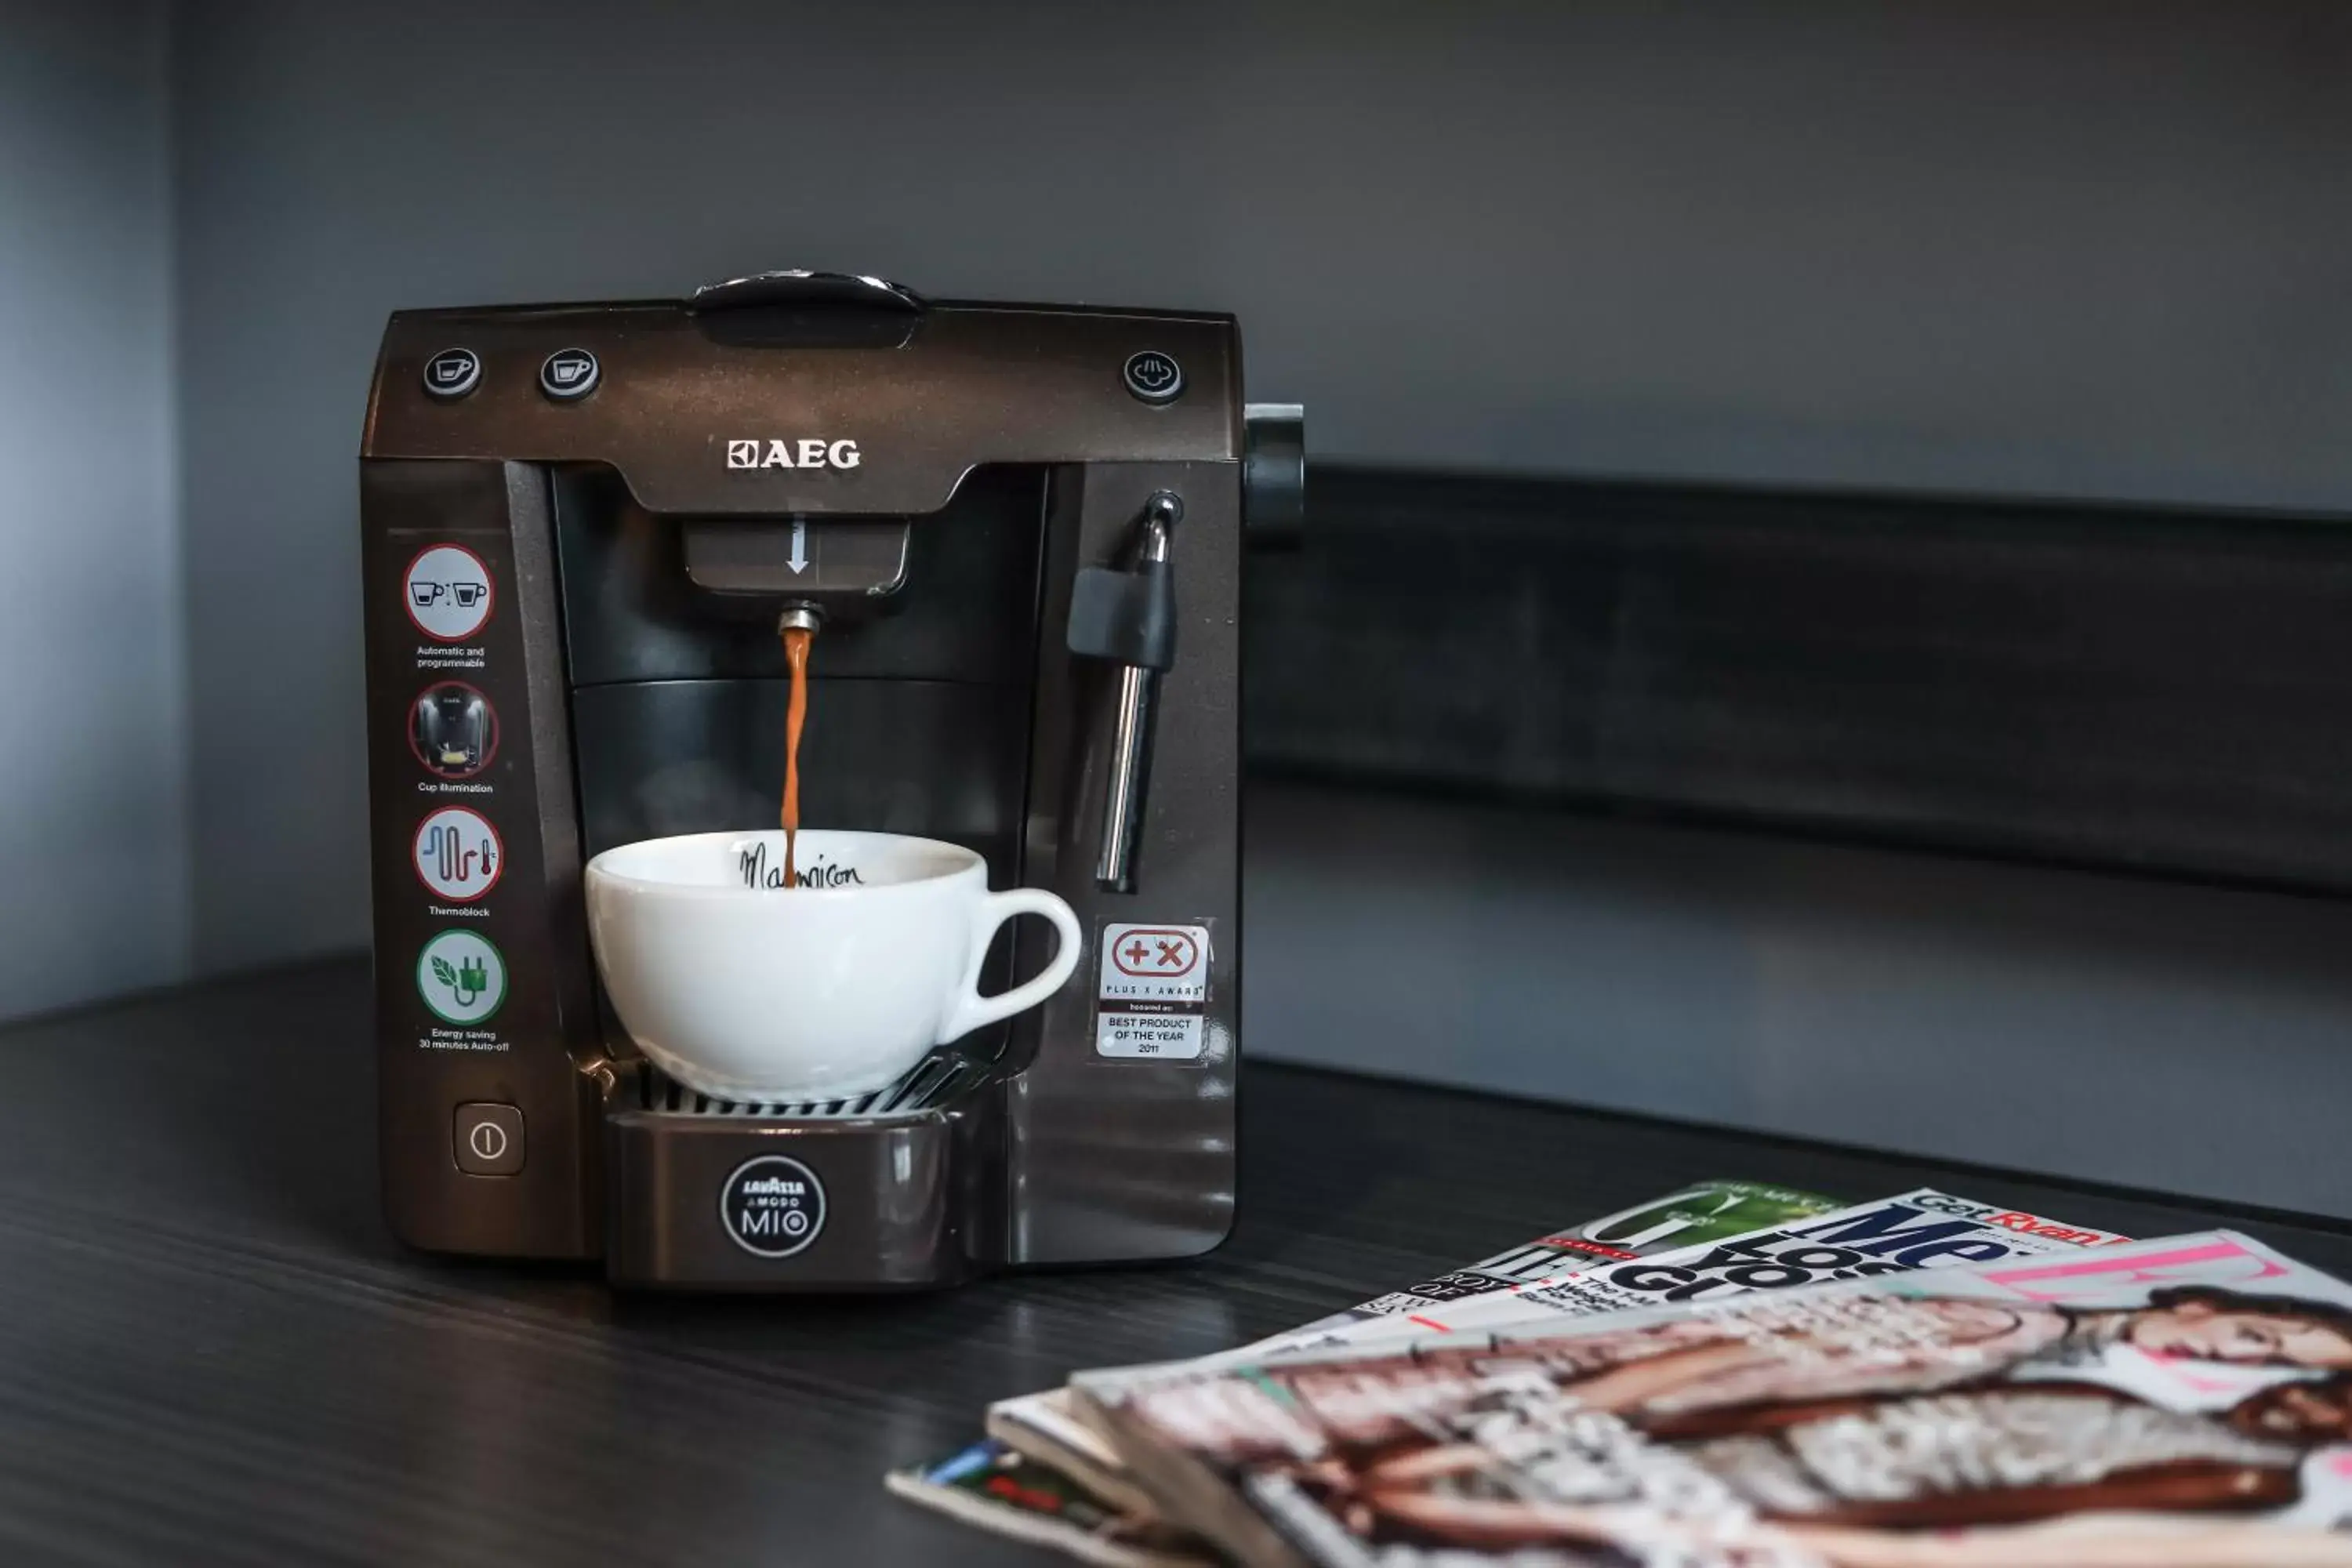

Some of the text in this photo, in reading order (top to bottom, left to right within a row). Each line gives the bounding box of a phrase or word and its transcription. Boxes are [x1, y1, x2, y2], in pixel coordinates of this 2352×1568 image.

[761, 440, 860, 468] AEG
[417, 646, 485, 656] Automatic and
[417, 658, 485, 668] programmable
[418, 782, 493, 793] Cup illumination
[428, 906, 490, 916] Thermoblock
[1106, 985, 1136, 994] PLUS
[1109, 1017, 1191, 1029] BEST PRODUCT
[432, 1028, 496, 1041] Energy saving
[1115, 1030, 1185, 1041] OF THE YEAR
[419, 1039, 510, 1051] 30 minutes Auto-off
[1138, 1044, 1160, 1053] 2011
[742, 1177, 805, 1193] LAVAZZA
[742, 1210, 808, 1236] MIO
[1911, 1194, 1996, 1220] Get
[1984, 1211, 2101, 1247] Ryan
